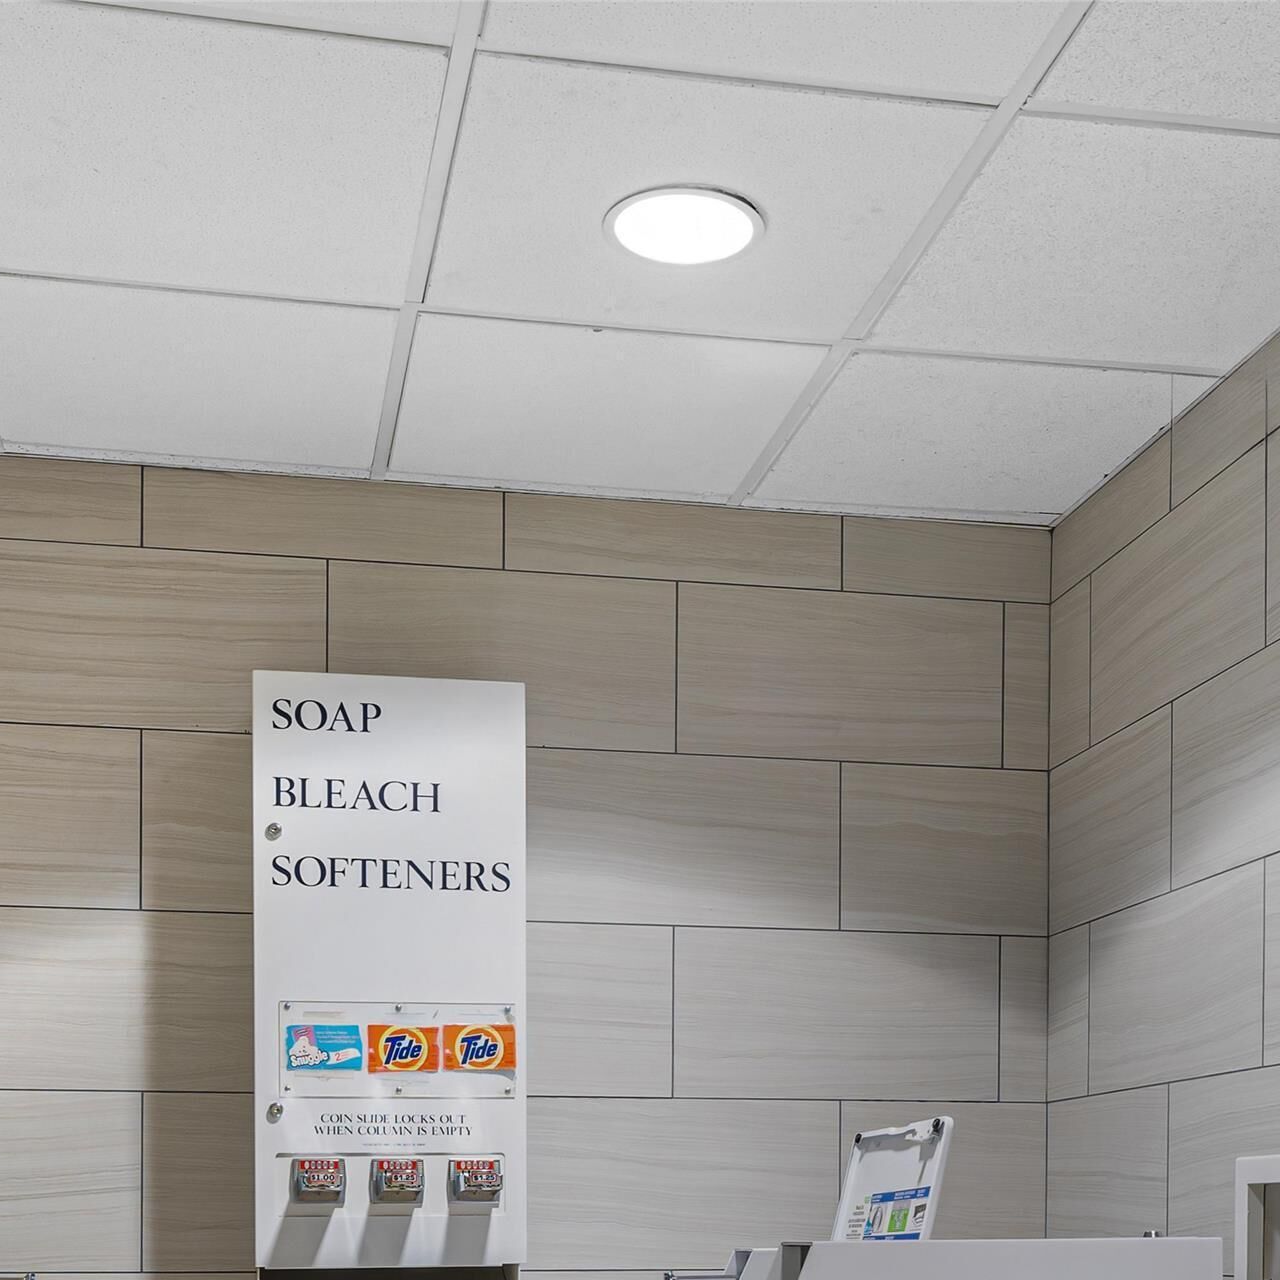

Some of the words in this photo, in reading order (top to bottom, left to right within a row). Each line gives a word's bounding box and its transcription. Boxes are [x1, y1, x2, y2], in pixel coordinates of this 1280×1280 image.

[272, 698, 382, 733] SOAP
[272, 776, 441, 813] BLEACH
[271, 855, 511, 892] SOFTENERS
[289, 1050, 329, 1067] Snuggle
[383, 1035, 422, 1065] Tide
[459, 1034, 498, 1065] Tide
[314, 1125, 354, 1135] WHEN
[357, 1125, 413, 1136] COLUMN
[417, 1126, 427, 1136] IS
[431, 1126, 473, 1136] EMPTY
[320, 1113, 353, 1124] COIN
[356, 1114, 390, 1124] SLIDE
[394, 1114, 436, 1124] LOCKS
[439, 1114, 467, 1124] OUT
